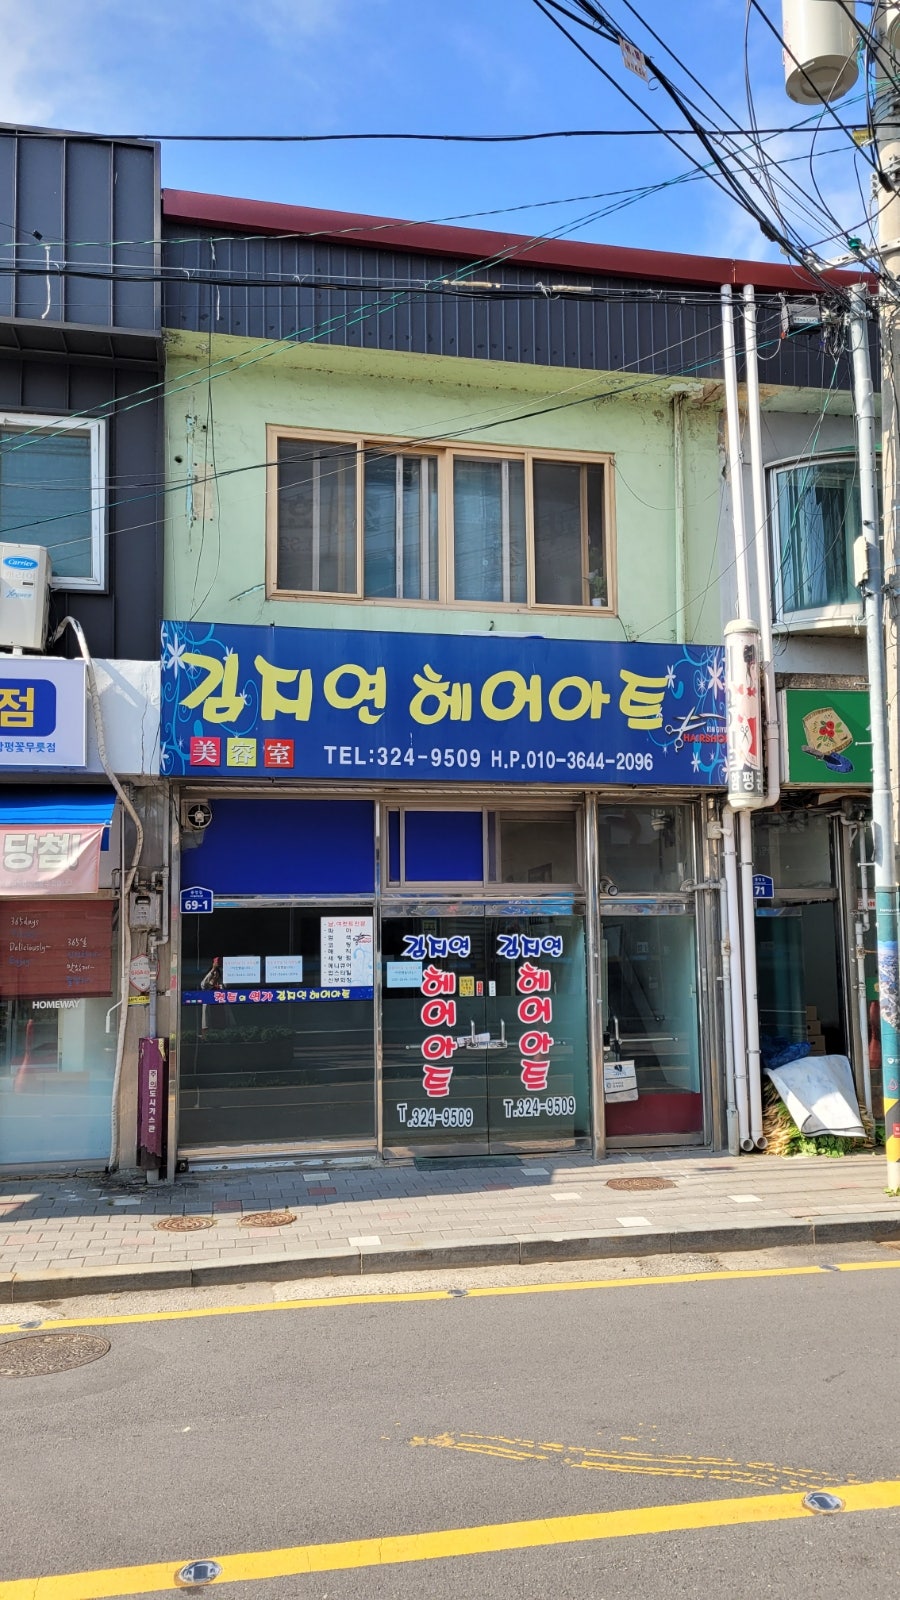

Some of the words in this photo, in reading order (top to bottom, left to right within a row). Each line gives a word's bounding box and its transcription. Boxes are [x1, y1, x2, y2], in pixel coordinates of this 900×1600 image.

[8, 558, 34, 567] Carrier
[178, 653, 387, 725] 김지연
[409, 663, 668, 730] 헤어아트
[0, 687, 35, 728] 점
[191, 739, 293, 767] 美容室
[323, 745, 481, 768] TEL:324-9509
[491, 750, 653, 771] H.P.010-3644-2096
[754, 885, 765, 895] 71
[184, 900, 208, 910] 69-1
[401, 935, 470, 959] 김지연
[496, 934, 563, 959] 김지연
[32, 1000, 80, 1009] HOMEWAY
[276, 990, 307, 1001] 김지연
[421, 964, 458, 1097] 헤어아트
[517, 962, 554, 1091] 헤어아트
[397, 1103, 473, 1127] T.324-9509
[503, 1096, 575, 1118] T.324-9509
